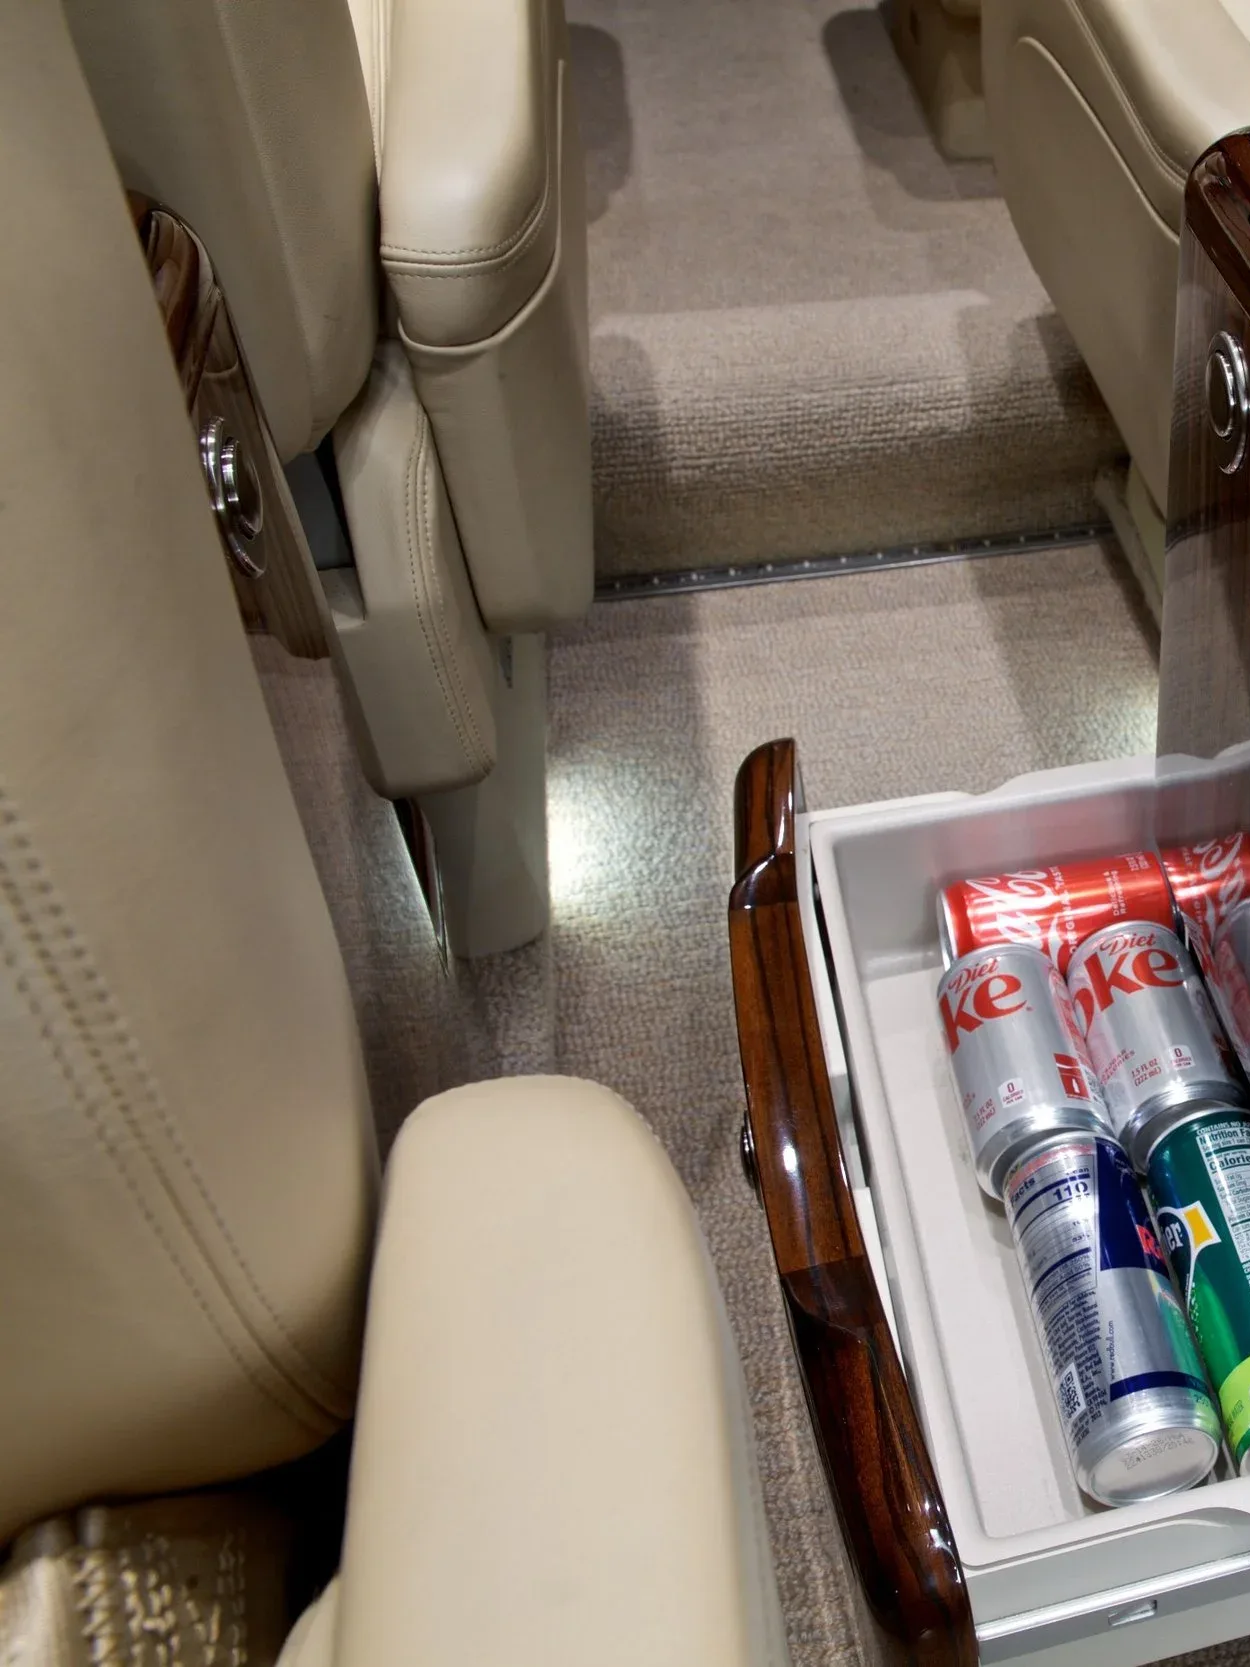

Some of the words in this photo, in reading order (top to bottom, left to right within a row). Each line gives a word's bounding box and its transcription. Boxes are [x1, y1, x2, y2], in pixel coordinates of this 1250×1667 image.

[1100, 933, 1156, 956] Diet
[948, 958, 999, 993] Diet
[938, 974, 1027, 1056] ke
[1174, 1047, 1183, 1058] 0
[1007, 1082, 1015, 1093] 0
[1053, 1181, 1089, 1201] 110
[1107, 1320, 1116, 1380] www.redbull.com
